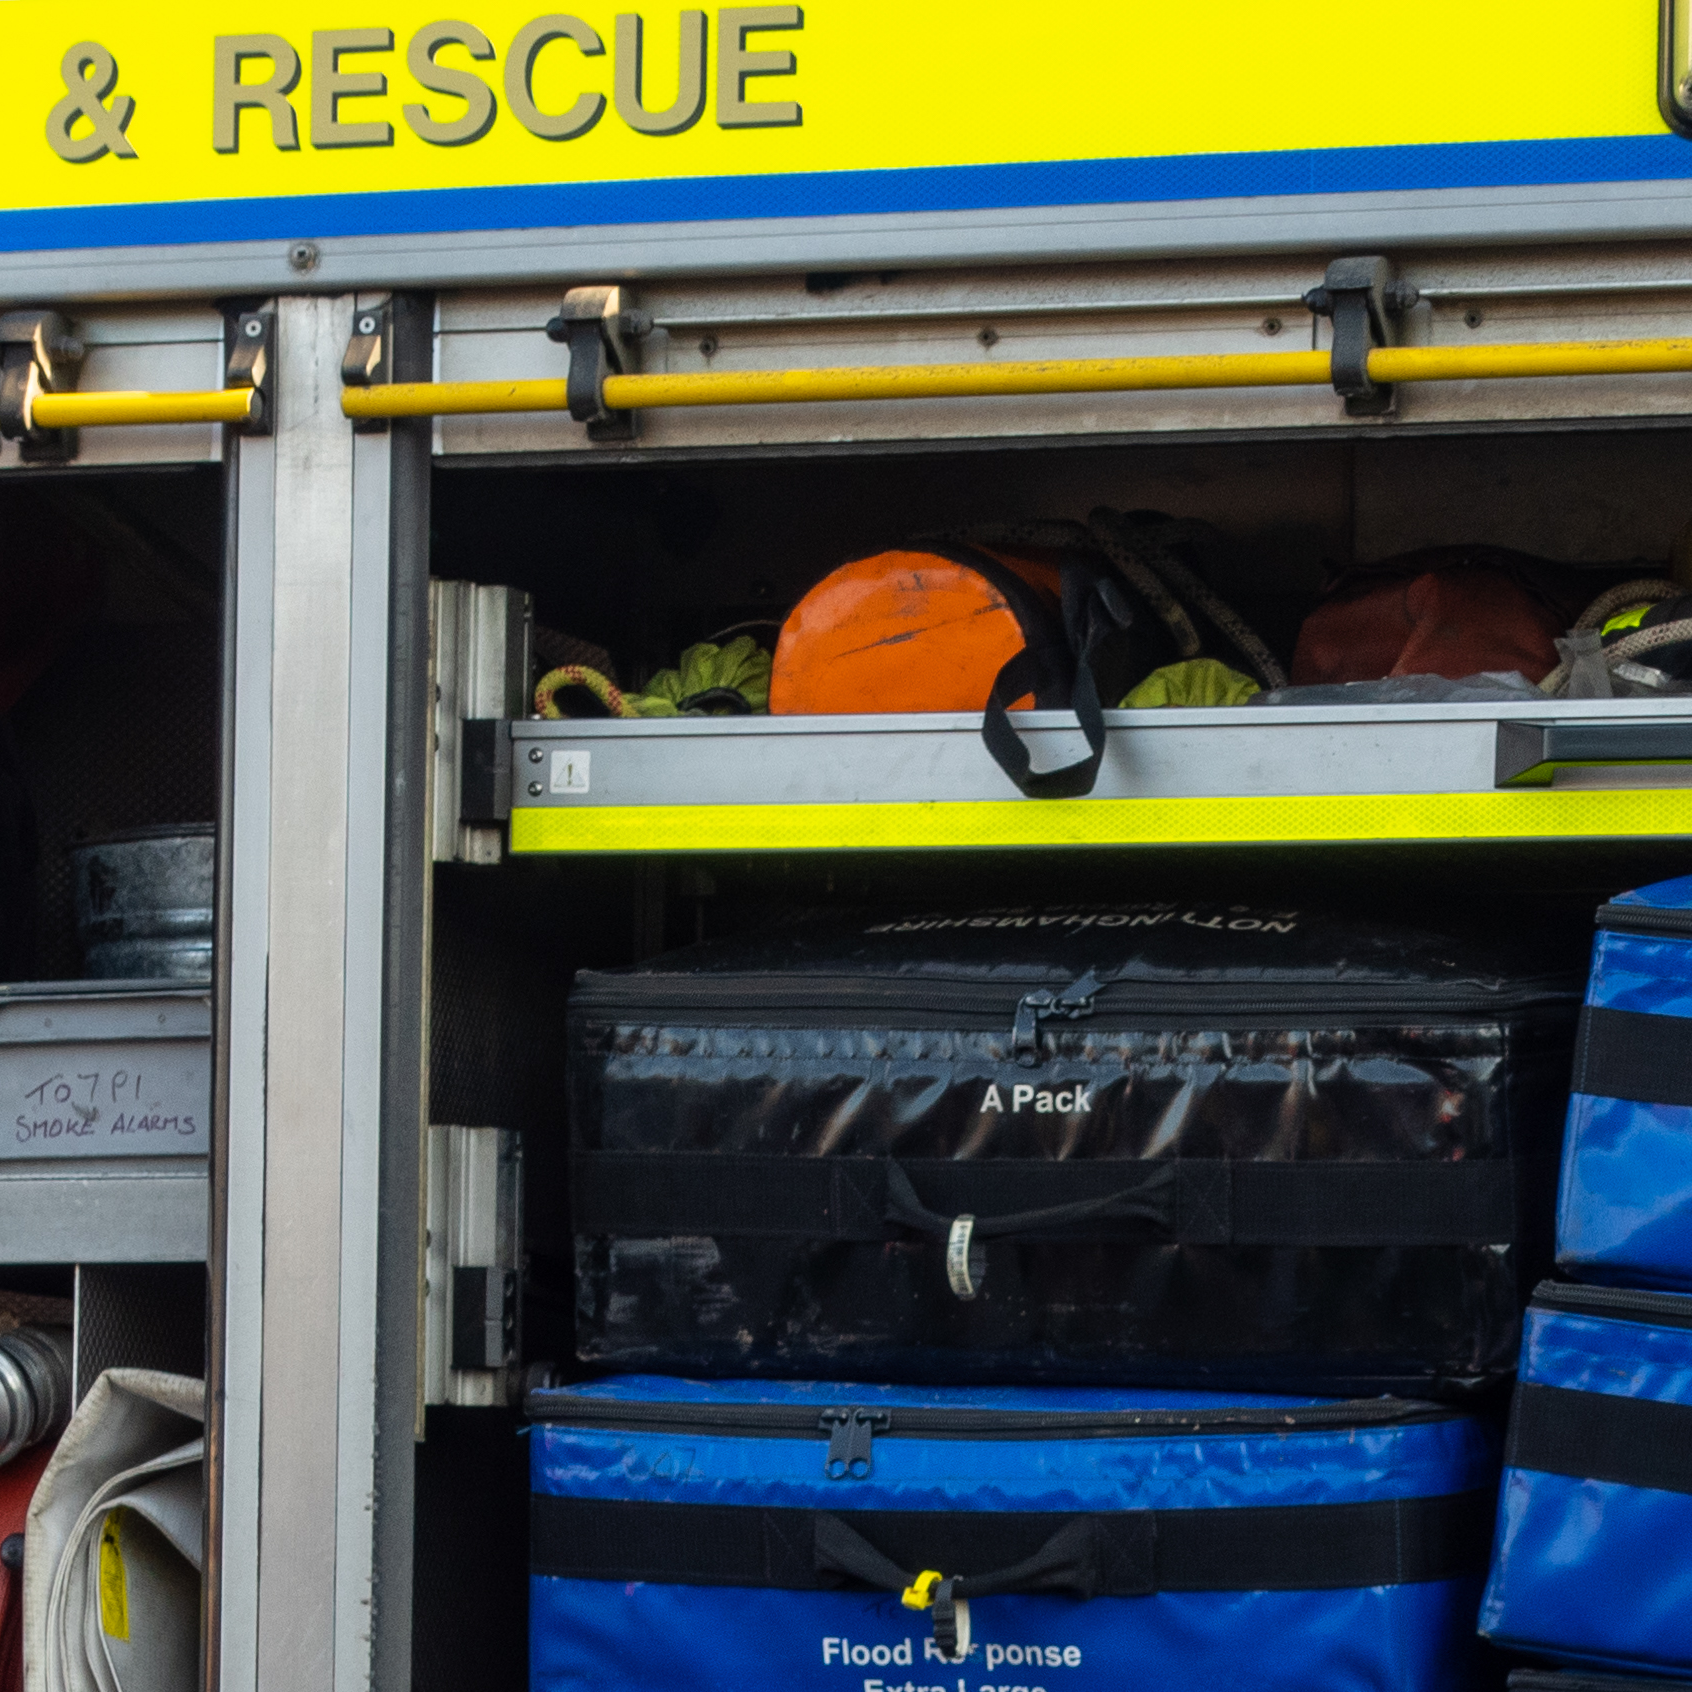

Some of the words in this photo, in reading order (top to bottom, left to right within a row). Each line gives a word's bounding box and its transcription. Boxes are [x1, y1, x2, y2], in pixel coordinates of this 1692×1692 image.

[44, 41, 139, 163] &
[211, 4, 805, 154] RESCUE
[979, 1084, 1004, 1113] A
[1012, 1084, 1092, 1113] Pack
[15, 1114, 95, 1143] SMOKE
[110, 1112, 197, 1136] ALARMS
[821, 1637, 913, 1666] Flood
